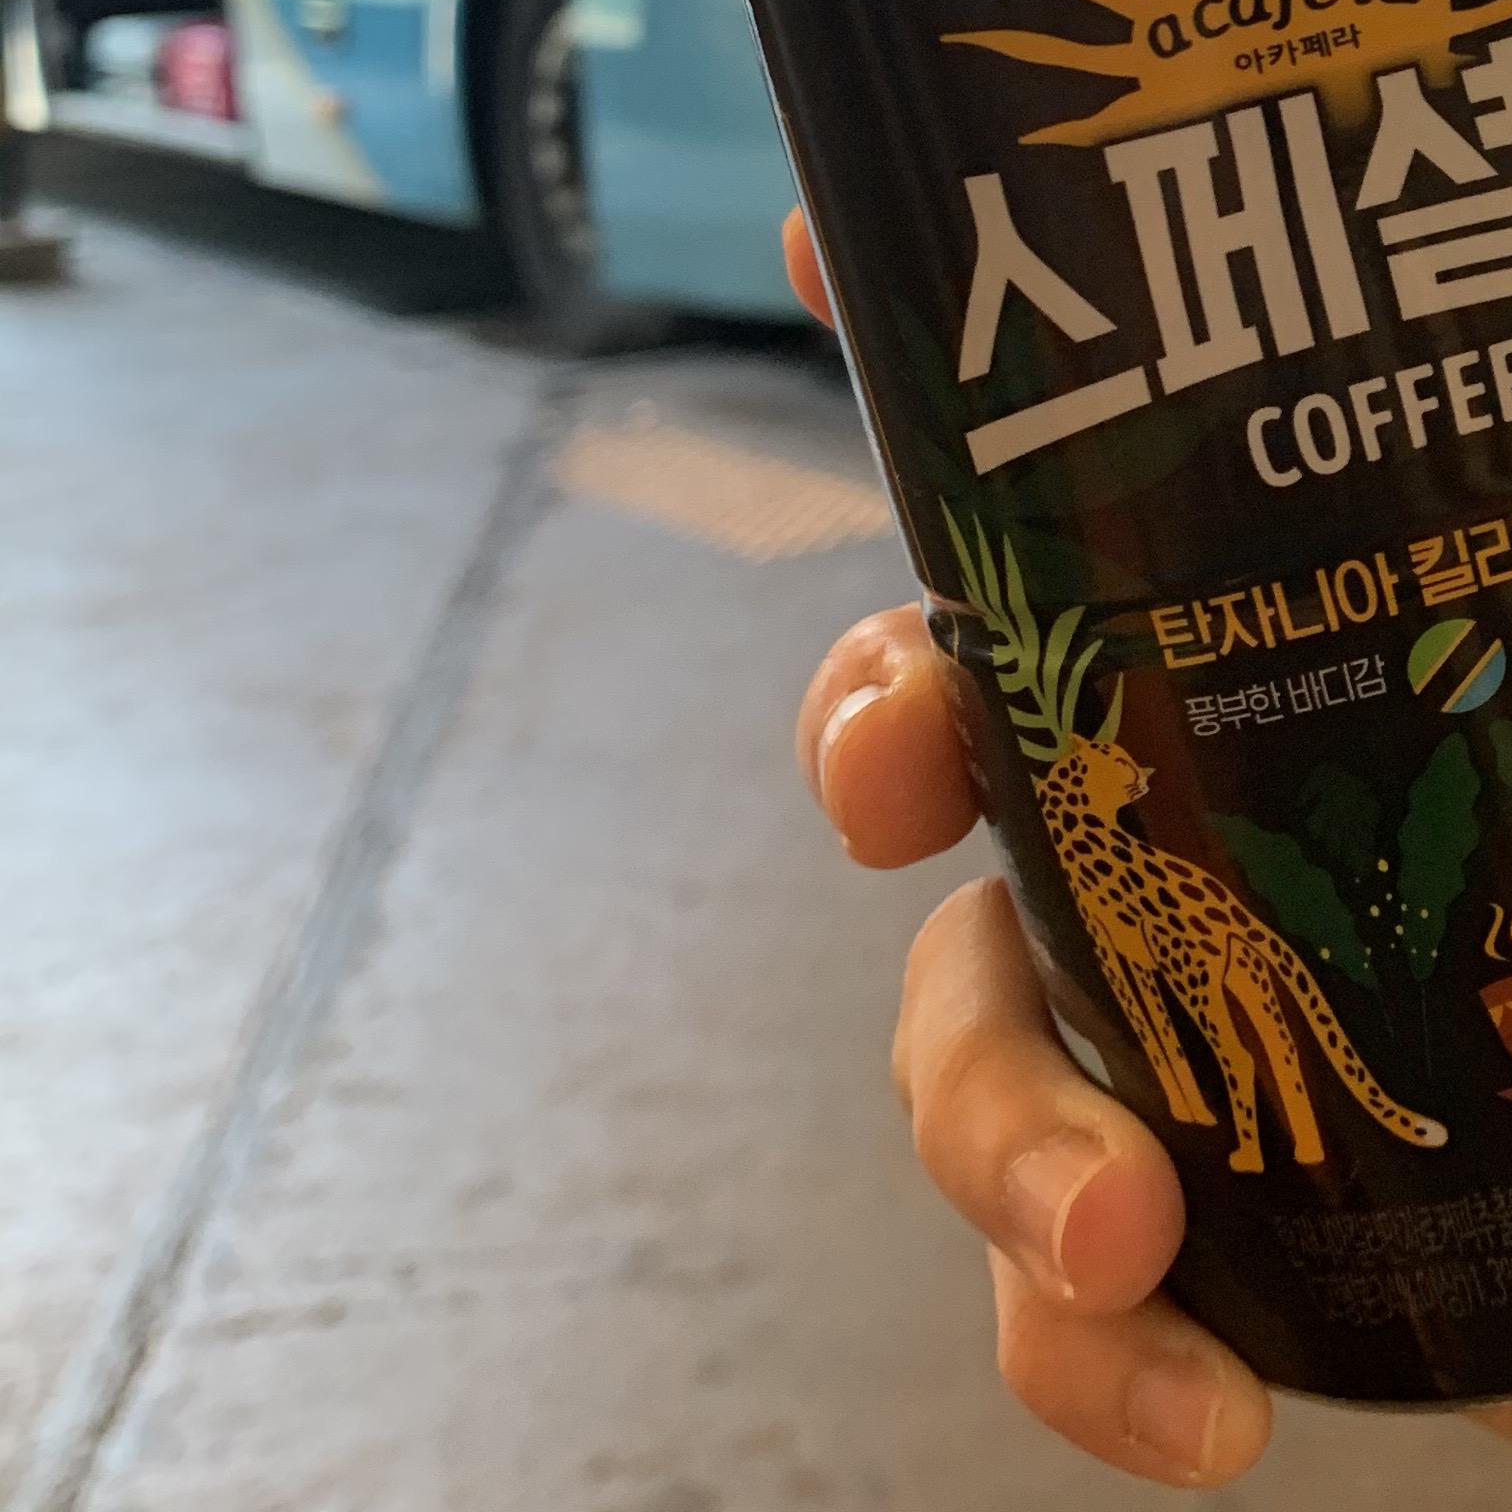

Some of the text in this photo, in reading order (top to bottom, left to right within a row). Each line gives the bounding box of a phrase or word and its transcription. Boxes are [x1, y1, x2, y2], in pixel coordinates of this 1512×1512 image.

[1234, 23, 1361, 75] 아카페라
[1149, 552, 1400, 670] 탄자니아
[1185, 654, 1388, 736] 풍부한 바디감
